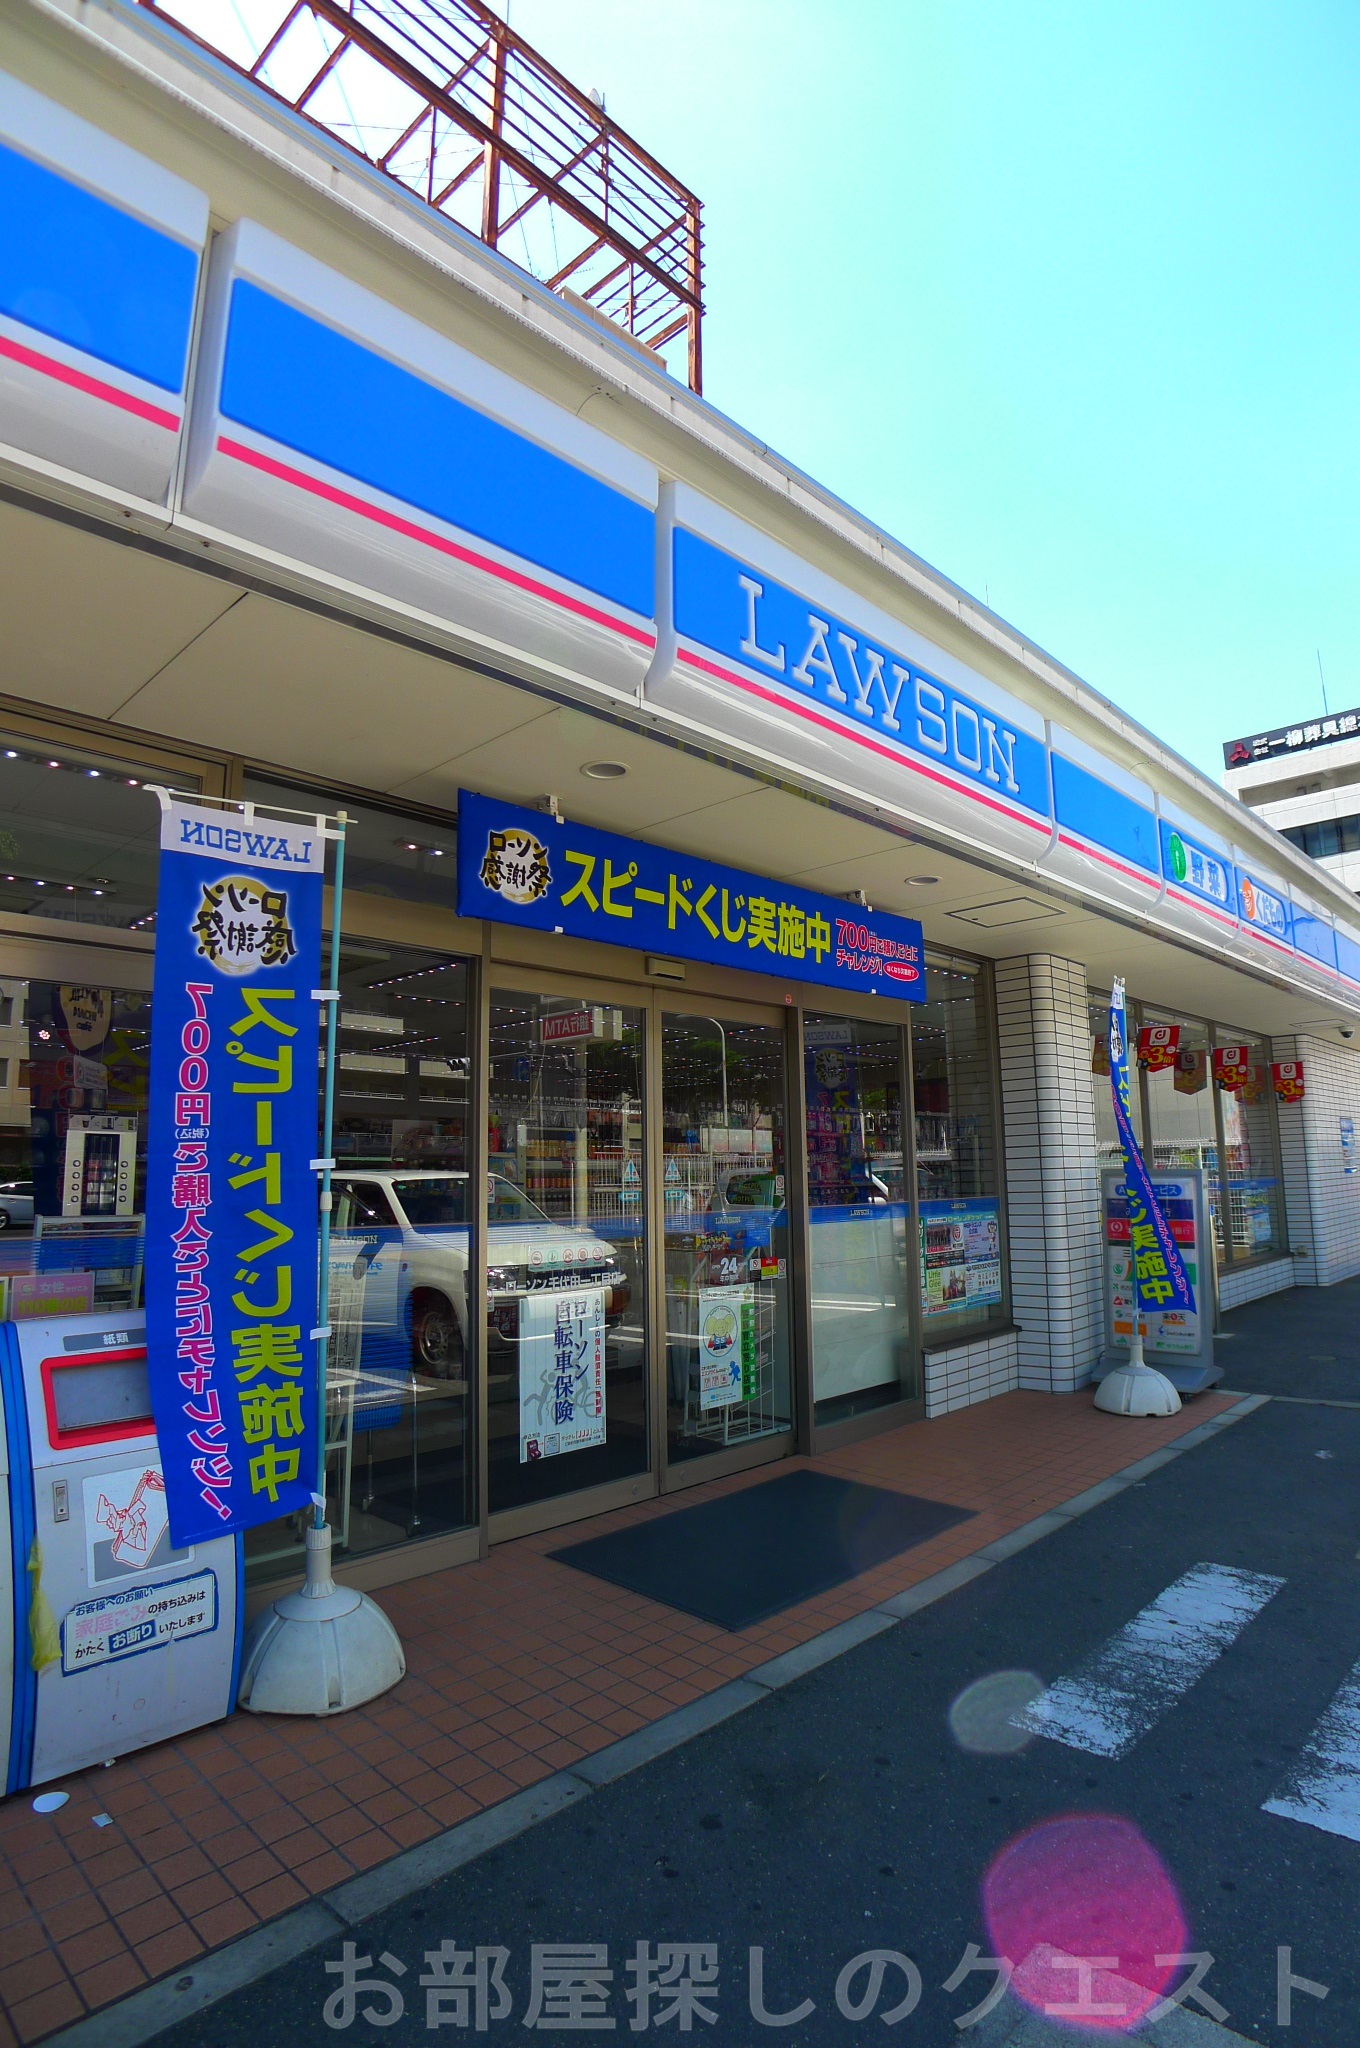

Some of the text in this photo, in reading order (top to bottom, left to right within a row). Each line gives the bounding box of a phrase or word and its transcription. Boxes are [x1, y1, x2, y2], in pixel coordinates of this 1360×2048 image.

[738, 570, 1020, 794] LAWSON
[488, 830, 549, 862] ローソン
[479, 852, 552, 898] 感謝祭
[1189, 849, 1224, 898] 野菜
[560, 848, 832, 965] スピードくじ実施中
[1255, 890, 1285, 929] くだもの
[836, 948, 883, 976] チャレンジ!
[720, 1257, 738, 1275] 24
[102, 1331, 130, 1346] 紙類
[573, 1299, 589, 1382] ローソン
[553, 1299, 575, 1426] 自転車保険
[75, 1587, 154, 1617] お客様へのお願い
